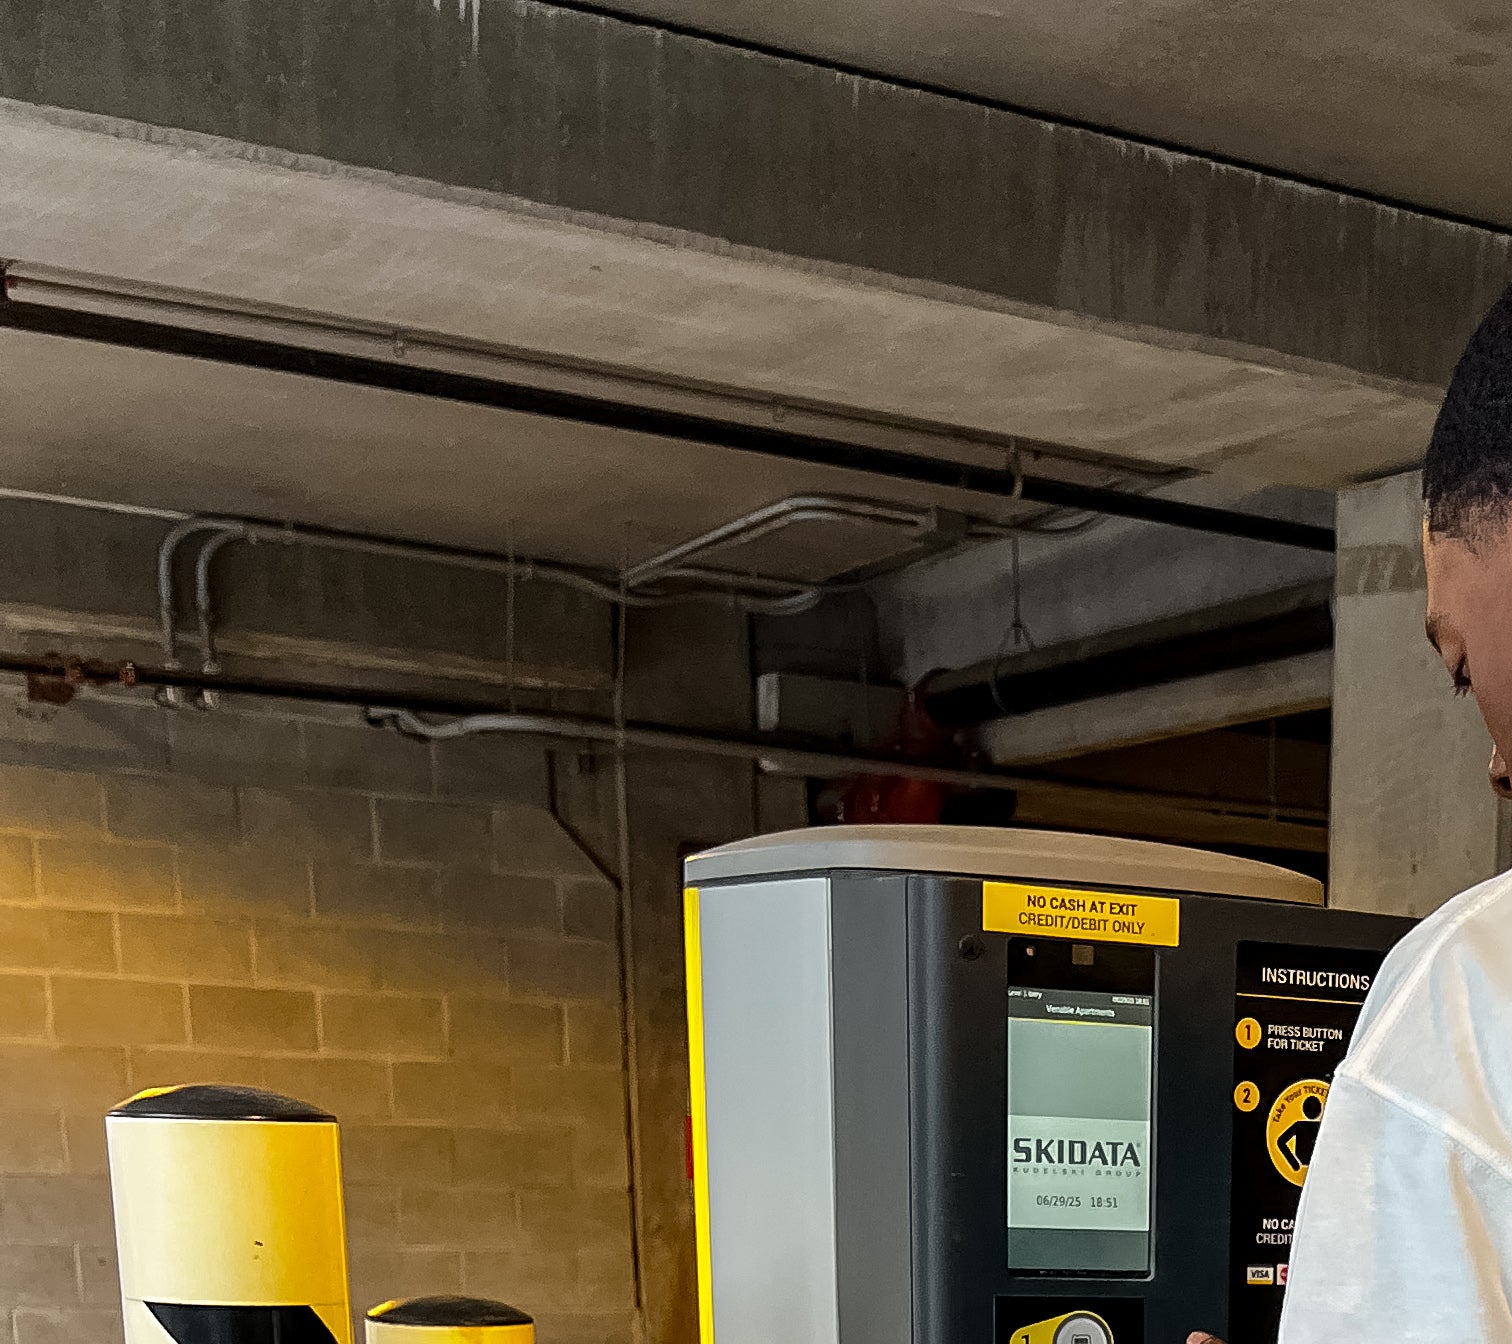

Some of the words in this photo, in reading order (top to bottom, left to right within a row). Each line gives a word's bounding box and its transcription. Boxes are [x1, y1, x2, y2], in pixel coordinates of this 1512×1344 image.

[1026, 894, 1046, 909] NO
[1050, 896, 1086, 913] CASH
[1089, 901, 1106, 914] AT
[1109, 903, 1138, 917] EXIT
[1018, 912, 1109, 932] CREDIT/DEBIT
[1112, 920, 1145, 935] ONLY
[1262, 966, 1370, 991] INSTRUCTIONS
[1245, 1024, 1251, 1041] 1
[1268, 1024, 1300, 1038] PRESS
[1302, 1026, 1343, 1041] BUTTON
[1267, 1037, 1289, 1050] FOR
[1290, 1039, 1325, 1052] TICKET
[1242, 1087, 1252, 1104] 2
[1013, 1137, 1141, 1168] SKIDATA
[1012, 1167, 1085, 1176] KUDELSKI
[1095, 1169, 1142, 1178] GROUP
[1036, 1195, 1082, 1208] 06/29/25
[1090, 1196, 1118, 1208] 18:51
[1262, 1218, 1280, 1230] NO
[1251, 1269, 1270, 1279] VISA
